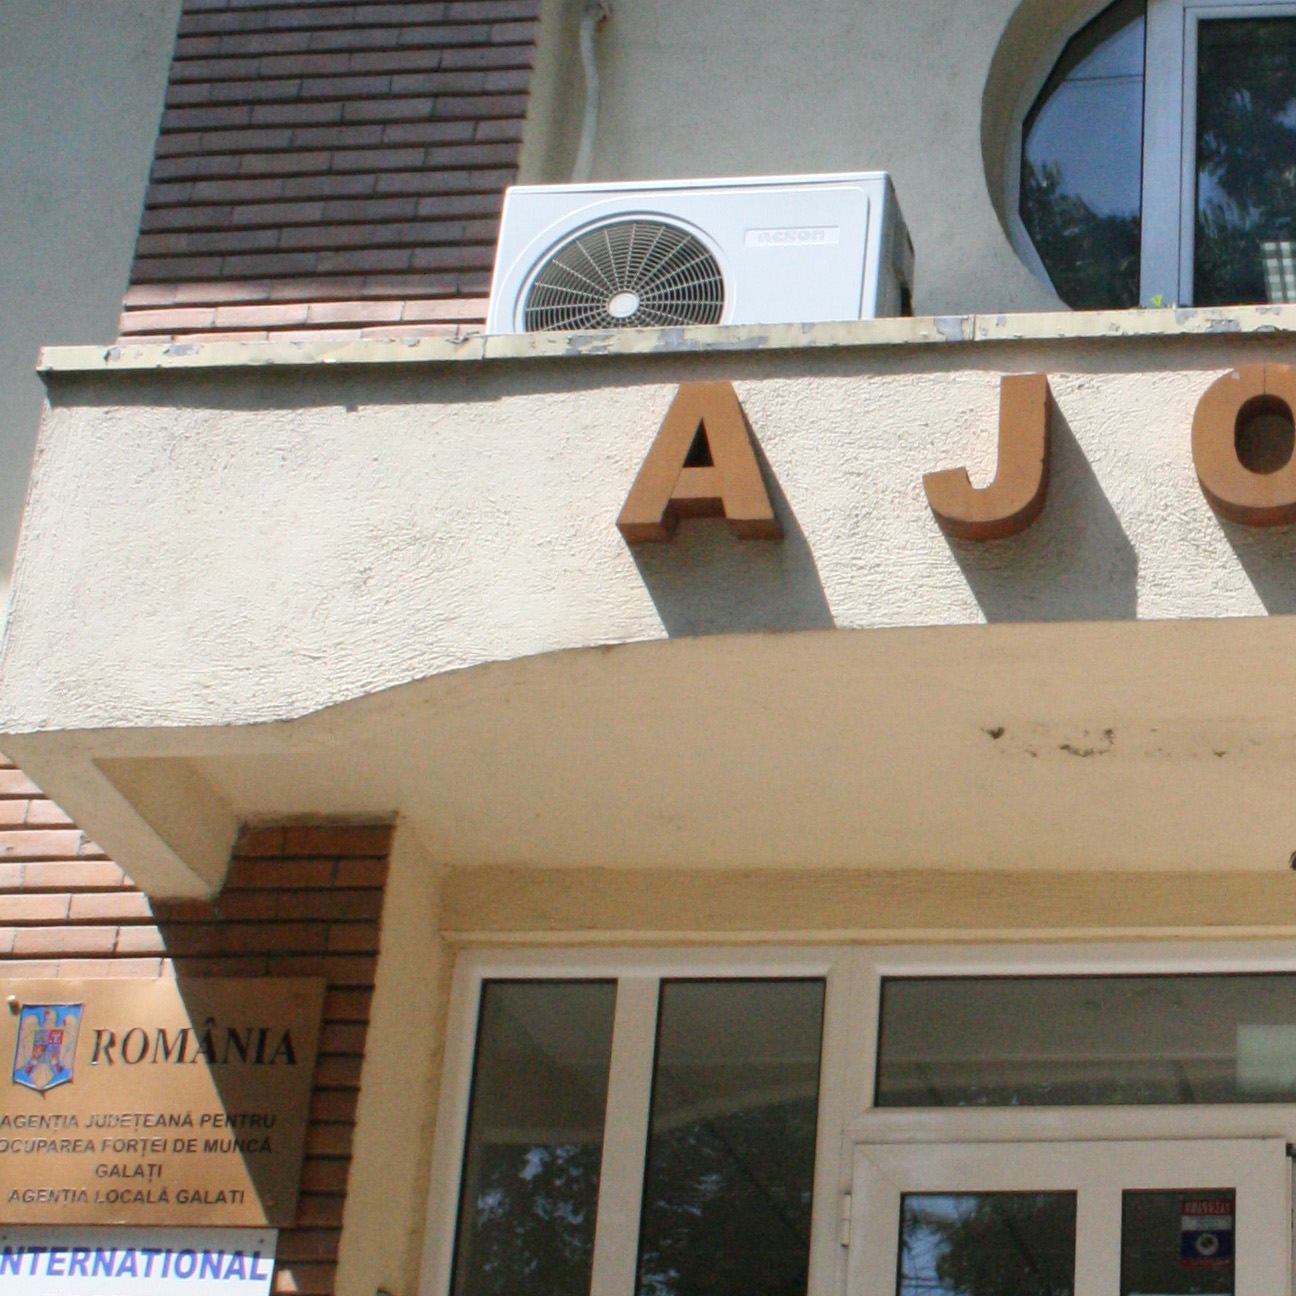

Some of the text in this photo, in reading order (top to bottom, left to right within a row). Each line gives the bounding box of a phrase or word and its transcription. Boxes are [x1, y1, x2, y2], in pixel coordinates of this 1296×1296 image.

[91, 1017, 296, 1066] ROMÂNIA
[200, 1113, 276, 1128] PENTRU
[0, 1138, 95, 1153] OCUPAREA
[173, 1138, 198, 1153] DE
[0, 1245, 269, 1281] NTERNATIONAL
